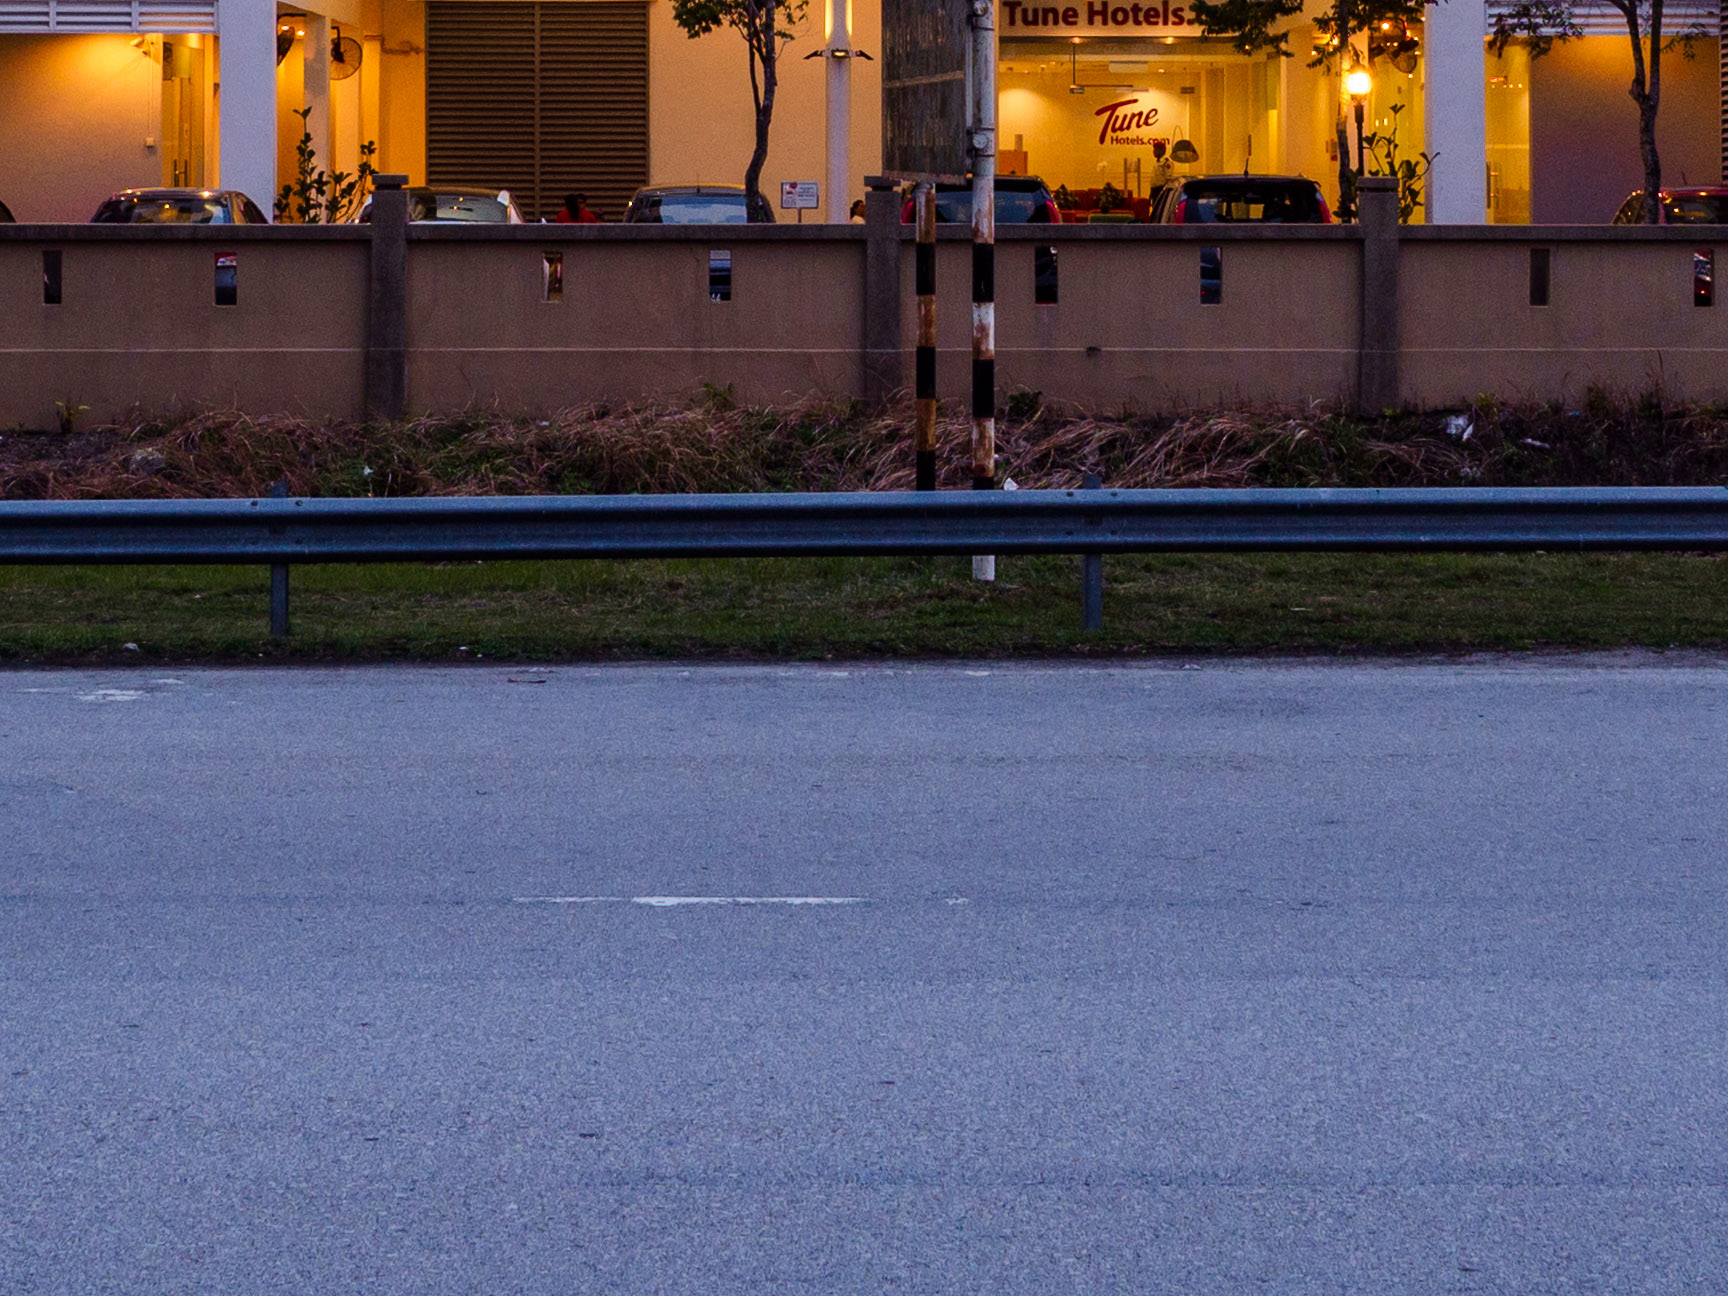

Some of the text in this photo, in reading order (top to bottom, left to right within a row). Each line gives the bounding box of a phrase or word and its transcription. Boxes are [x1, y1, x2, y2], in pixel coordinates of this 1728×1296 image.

[1002, 0, 1206, 27] Tune Hotels.
[1094, 98, 1159, 145] Tune
